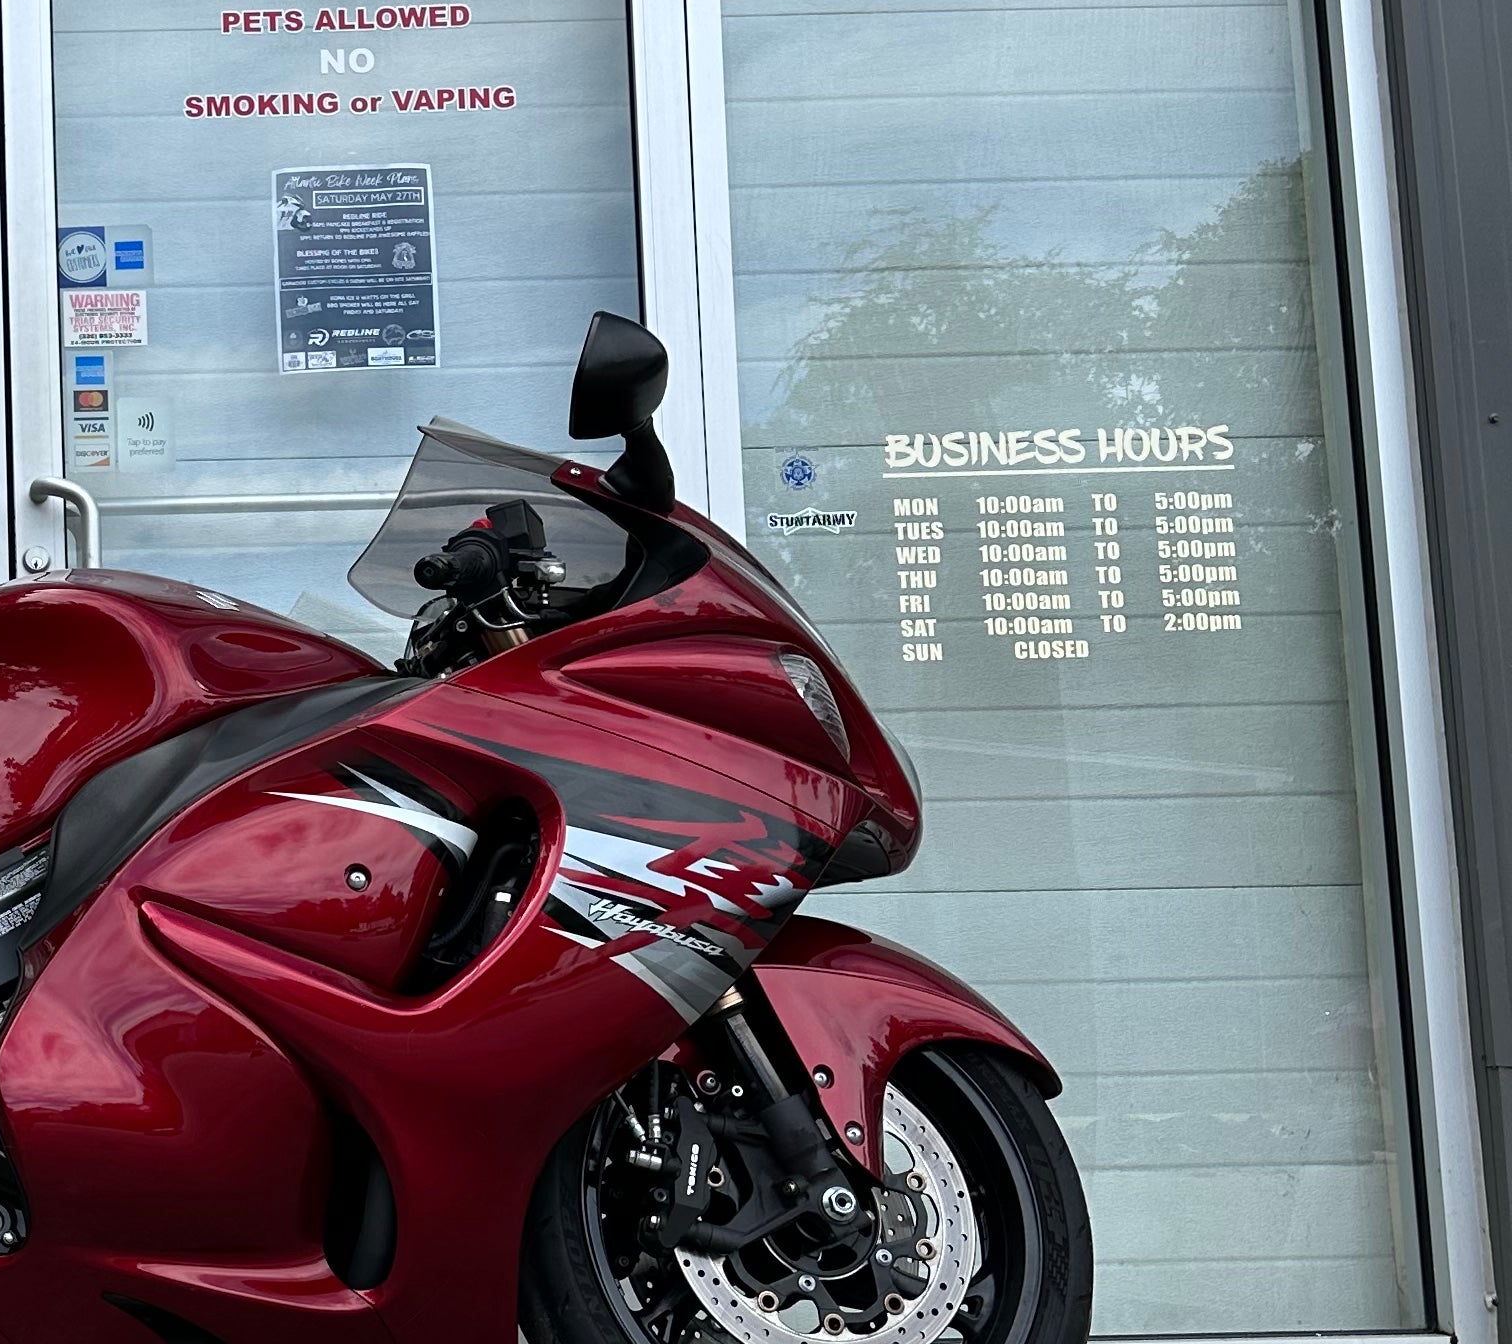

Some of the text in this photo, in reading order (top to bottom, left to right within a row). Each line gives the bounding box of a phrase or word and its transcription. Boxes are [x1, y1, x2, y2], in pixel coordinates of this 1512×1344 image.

[221, 5, 471, 33] PETS ALLOWED
[320, 47, 375, 74] NO
[184, 87, 516, 118] SMOKING or VAPING
[326, 174, 350, 187] Bike
[355, 174, 383, 187] Week
[317, 191, 421, 205] SATURDAY MAY 27TH
[69, 293, 141, 309] WARNING
[98, 315, 141, 325] SECURITY
[331, 328, 381, 337] REDLINE
[78, 423, 106, 433] VISA
[127, 438, 167, 448] Tap to pay
[129, 447, 165, 458] preferred
[885, 424, 1234, 469] BUSINESS HOURS
[893, 491, 1233, 517] MON 10:00am TO 5:00pm
[768, 513, 856, 528] STUNTARMY
[894, 515, 1234, 541] TUES 10:00am TO 5:00pm
[895, 540, 1236, 565] WED 10:00am TO 5:00pm
[897, 564, 1238, 589] THU 10:00am TO 5:00pm
[899, 588, 1241, 613] FRI 10:00am TO 5:00pm
[900, 613, 1242, 637] SAT 10:00am TO 2:00pm
[902, 640, 1089, 662] SUN CLOSED
[587, 898, 725, 956] Hayabusa
[686, 1143, 700, 1196] TOKICO
